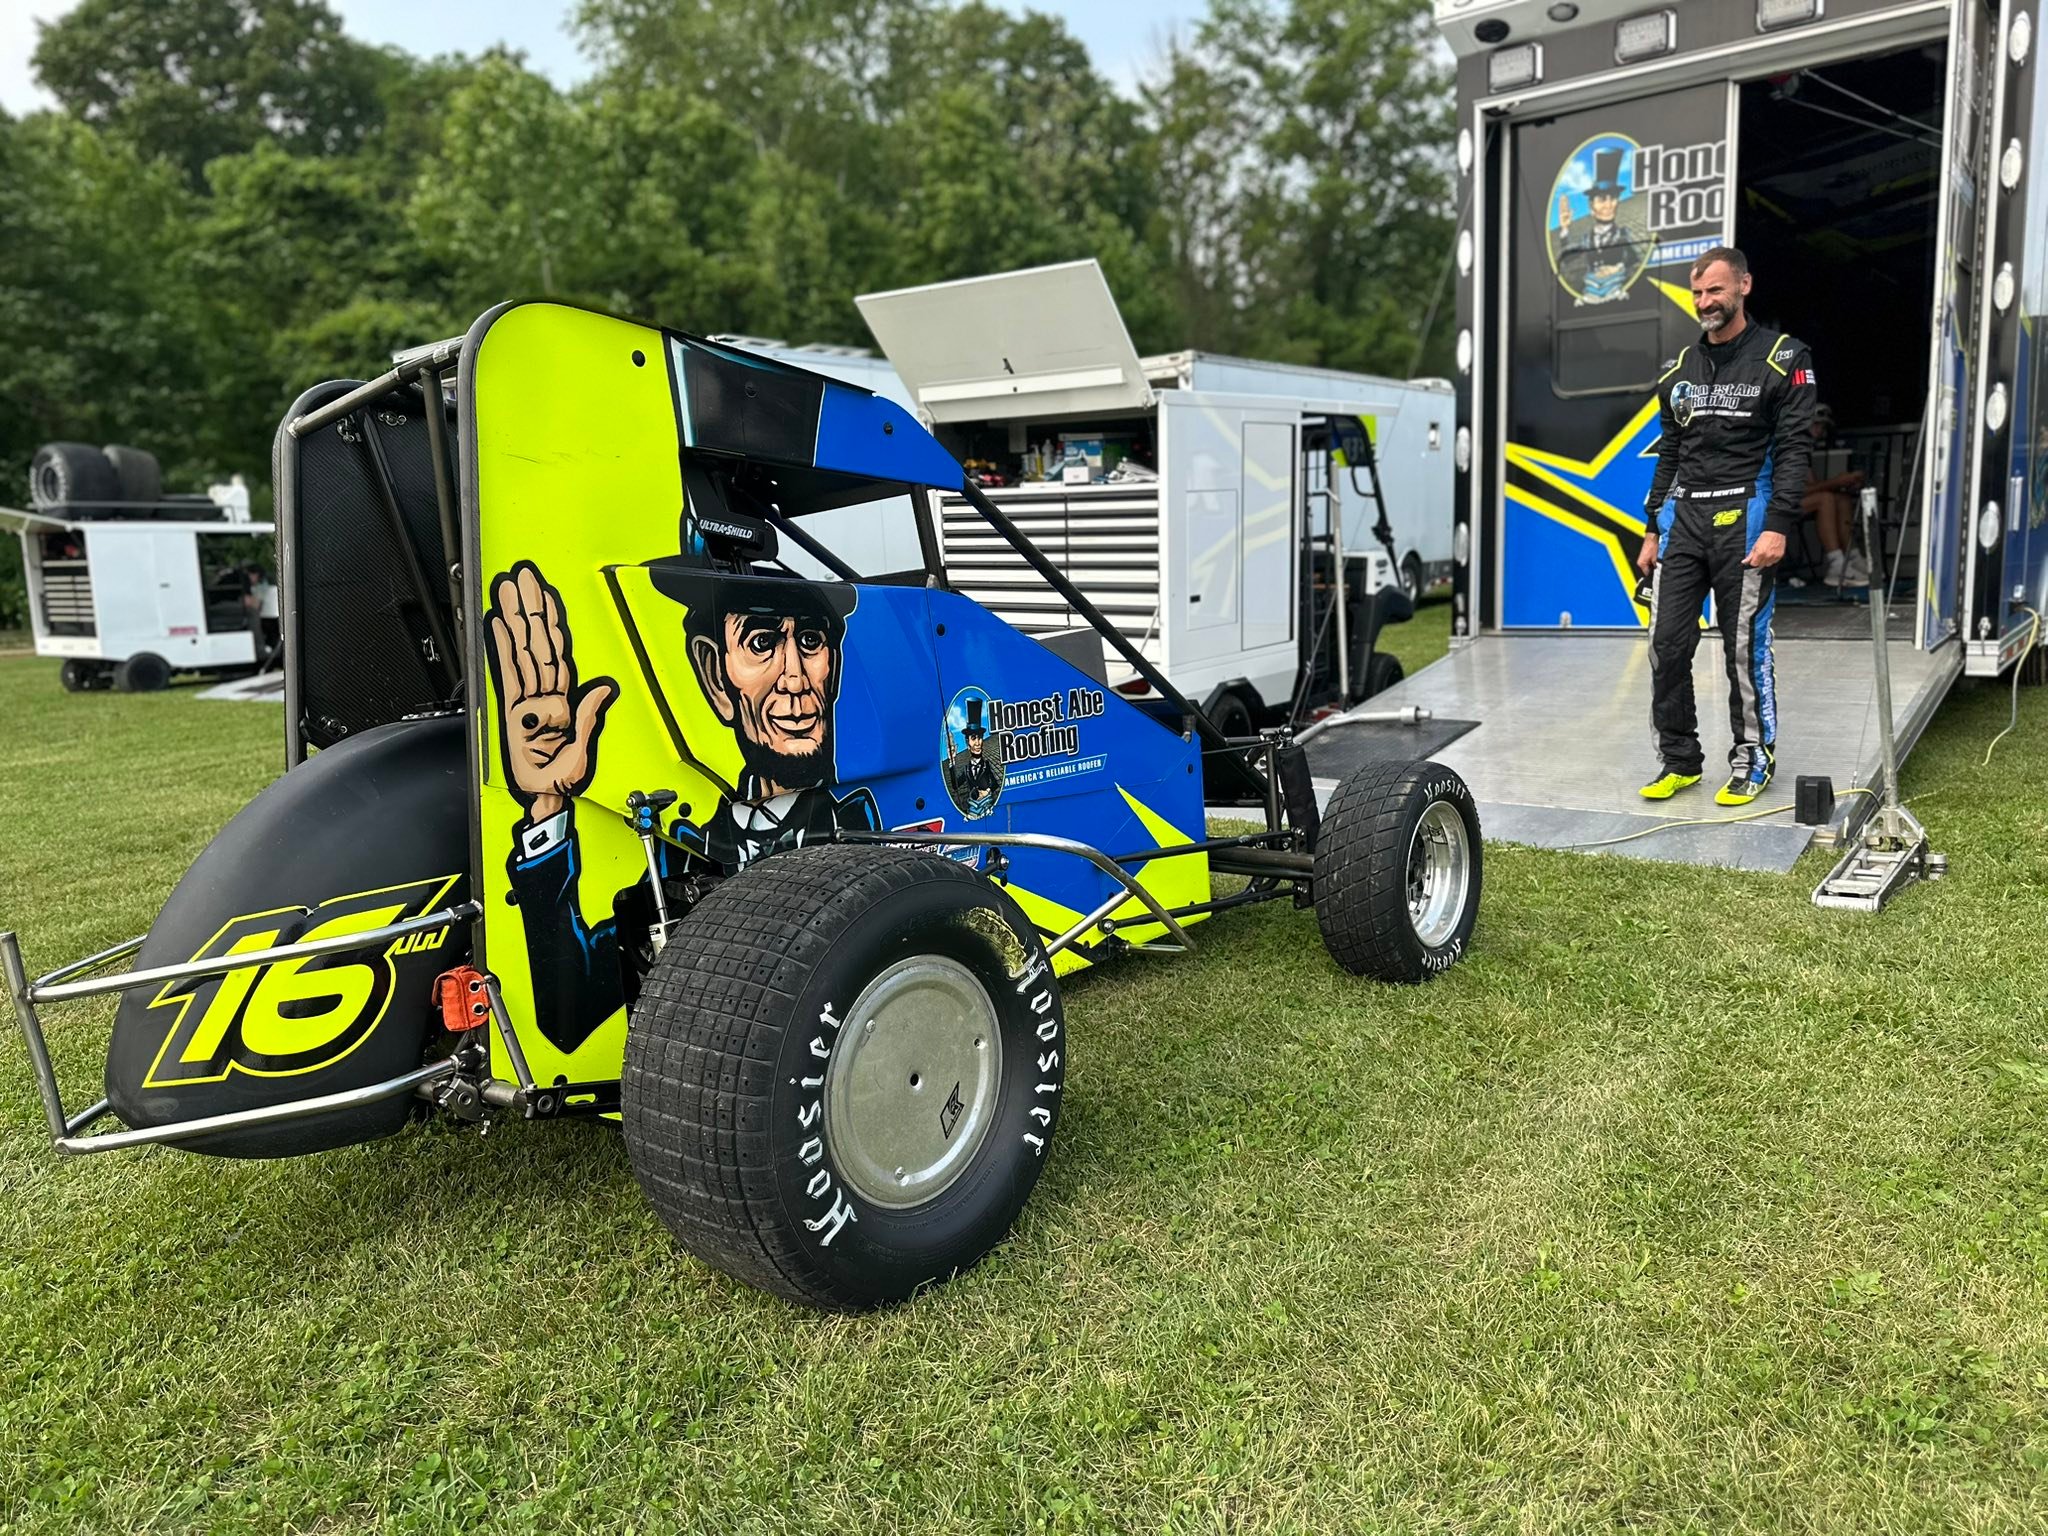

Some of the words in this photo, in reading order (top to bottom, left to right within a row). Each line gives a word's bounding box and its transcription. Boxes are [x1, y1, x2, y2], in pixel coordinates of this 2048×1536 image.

[1734, 383, 1760, 397] Abe
[987, 691, 1065, 733] Honest
[1067, 687, 1105, 720] Abe
[998, 724, 1080, 764] Roofing
[1004, 770, 1043, 787] AMERICA'S
[1045, 764, 1076, 778] RELIABLE
[1078, 759, 1102, 772] ROOFER
[1424, 774, 1467, 807] Hoosier
[1421, 938, 1462, 971] Hoosier
[1009, 946, 1062, 1157] Hoosier
[789, 1002, 858, 1247] Hoosier
